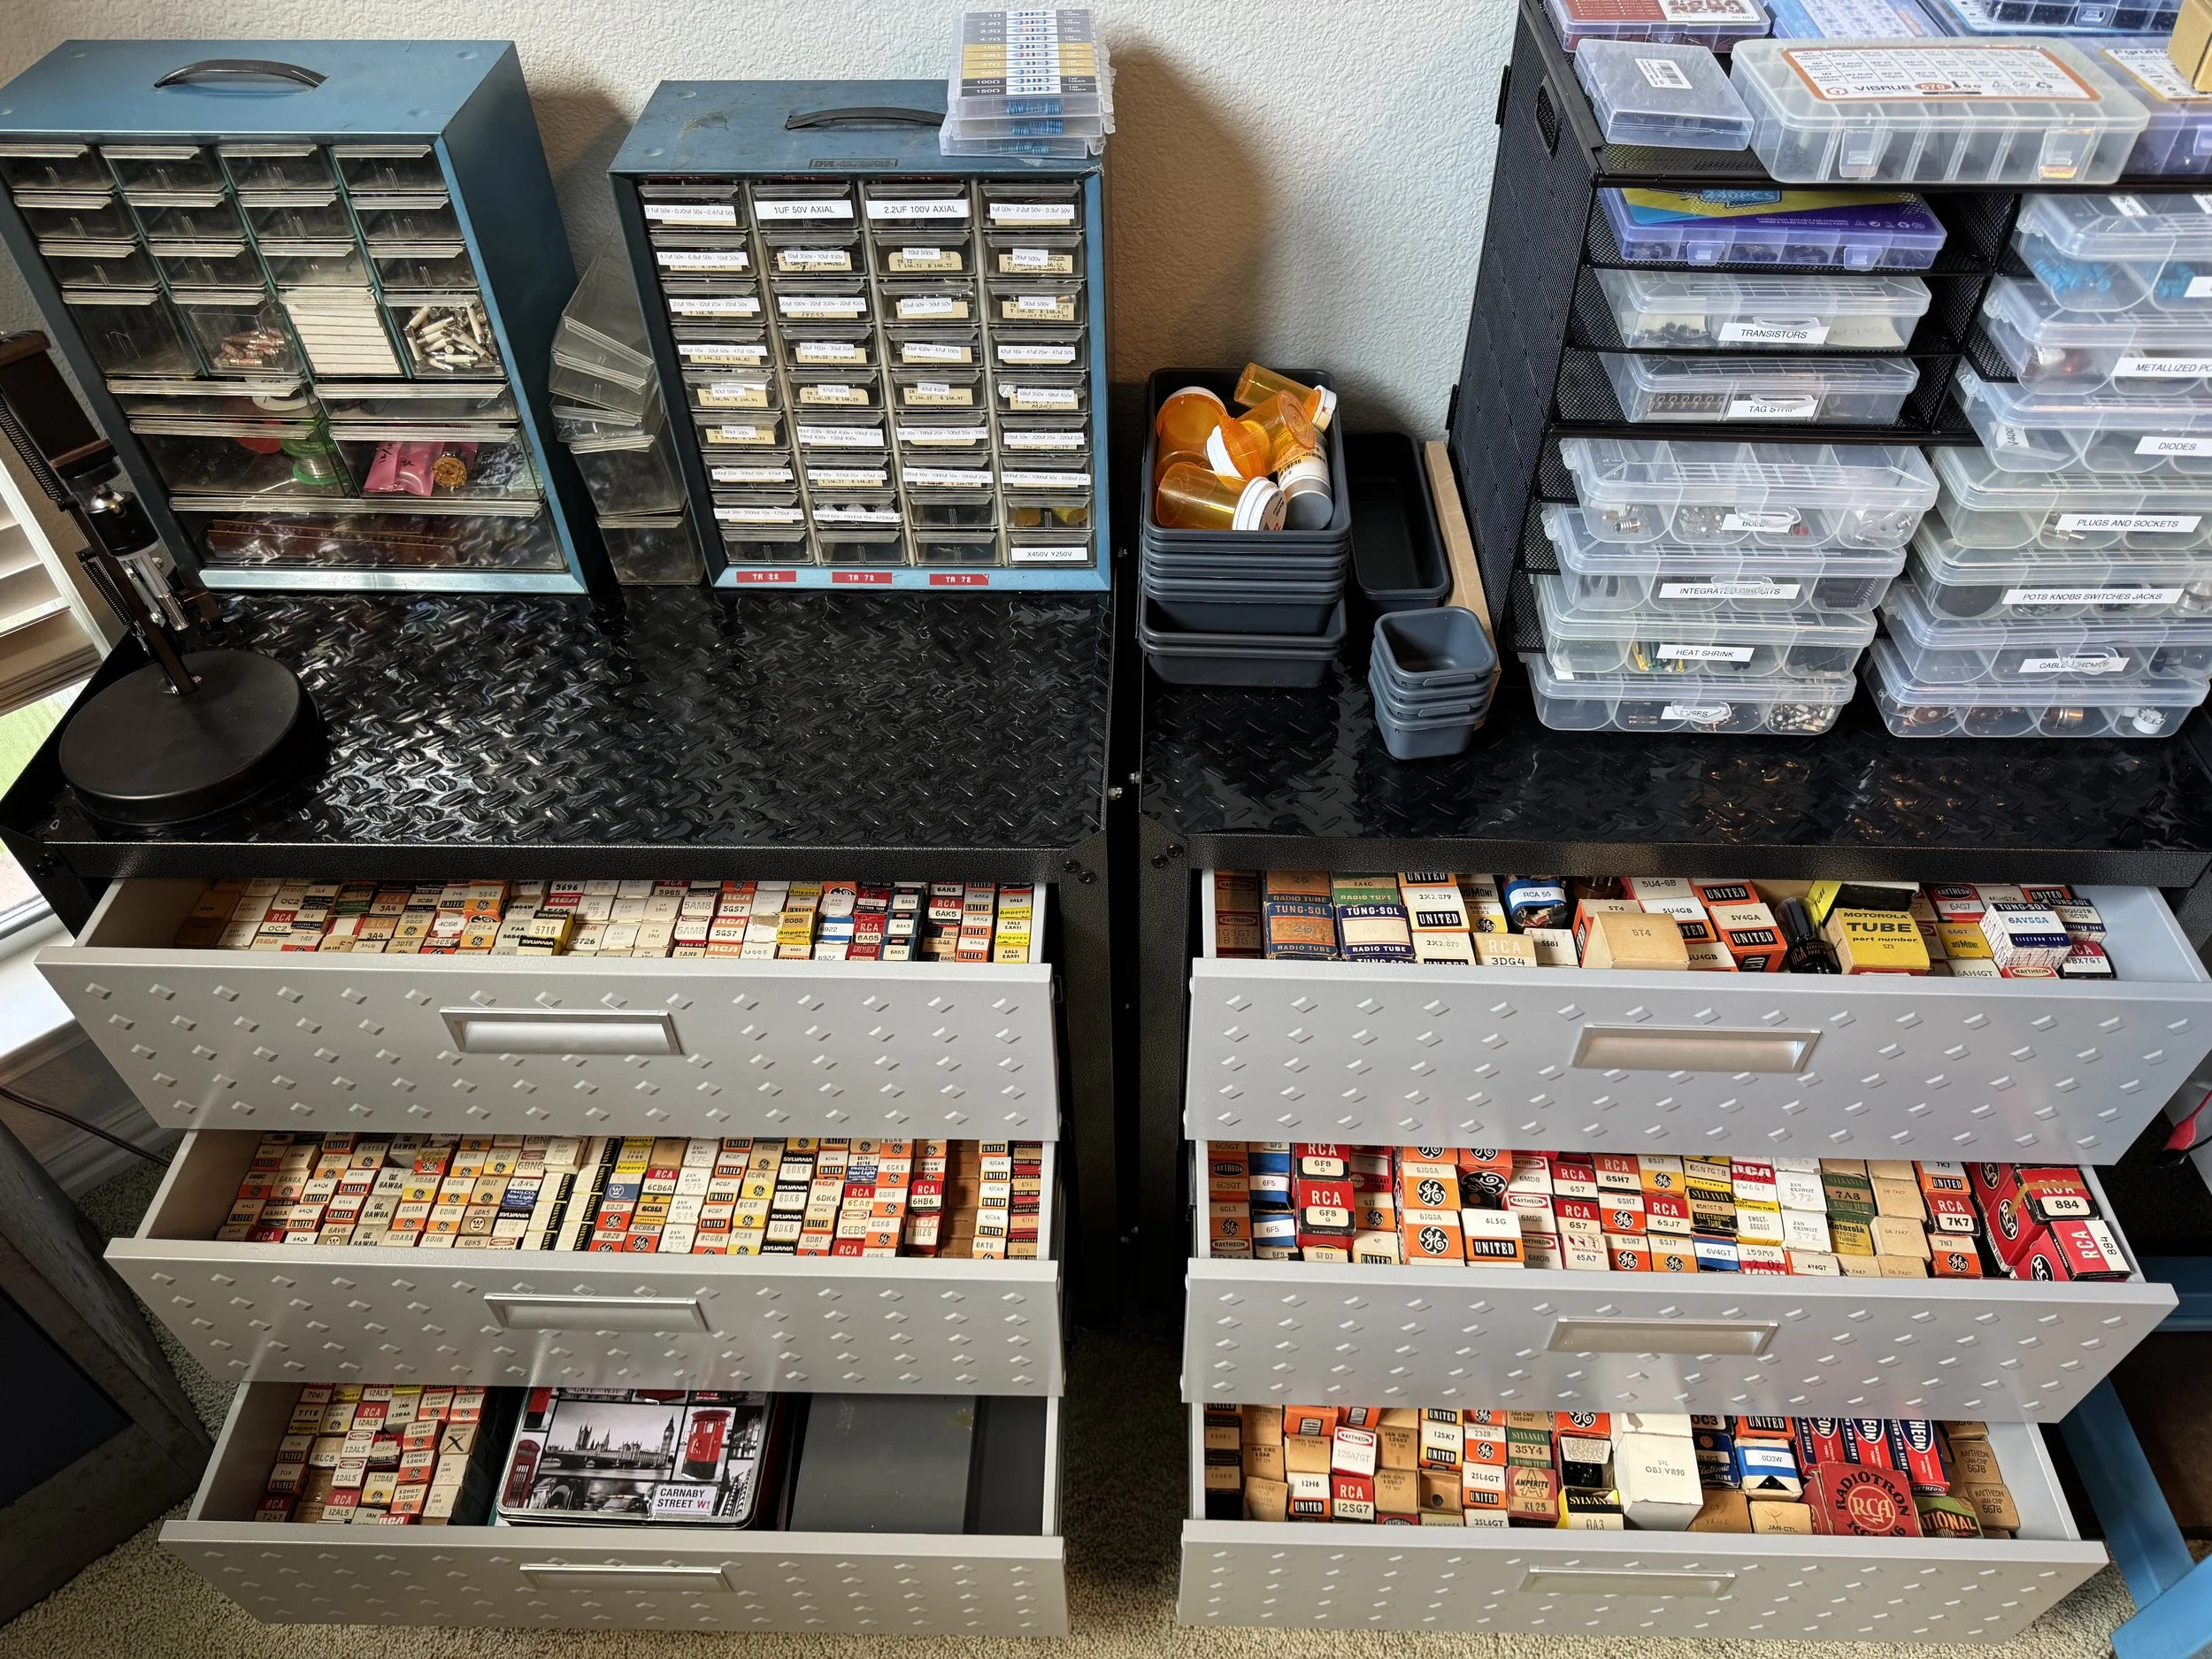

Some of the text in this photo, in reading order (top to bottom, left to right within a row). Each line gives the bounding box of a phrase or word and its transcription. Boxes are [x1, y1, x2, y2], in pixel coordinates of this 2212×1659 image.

[1741, 329, 1807, 339] TRANSISTORS
[1706, 887, 1746, 899] UNITED
[1938, 887, 1970, 897] RAYTHEON
[1276, 906, 1327, 915] TUNG-SOL
[1419, 913, 1459, 925] UNITED
[1847, 922, 1911, 933] TUBE
[1732, 932, 1773, 943] UNITED
[1489, 939, 1522, 954] RCA
[1308, 1144, 1338, 1156] RCA
[1604, 1159, 1630, 1171] RCA
[1561, 1169, 1586, 1180] RCA
[1933, 1179, 1962, 1188] UNITED
[1312, 1190, 1341, 1205] RCA
[1837, 1191, 1861, 1200] 7A8
[1653, 1202, 1678, 1216] RCA
[1938, 1201, 1964, 1212] RCA
[2055, 1200, 2079, 1209] 884
[1565, 1205, 1590, 1218] RCA
[1947, 1217, 1969, 1226] 7K7
[256, 1232, 274, 1240] RCA
[839, 1245, 857, 1254] RCA
[1475, 1241, 1515, 1255] UNITED
[2075, 1231, 2100, 1259] RCA
[2100, 1236, 2116, 1255] 884
[363, 1408, 380, 1417] RCA
[1749, 1417, 1784, 1429] UNITED
[1340, 1432, 1370, 1443] RAYTHEON
[1427, 1449, 1455, 1462] UNITED
[1515, 1446, 1543, 1455] 35Y4
[1471, 1472, 1499, 1482] 25L6GT
[1515, 1479, 1548, 1488] AMPERITE
[660, 1488, 704, 1498] CARNABY
[1340, 1485, 1363, 1499] RCA
[1470, 1492, 1498, 1503] UNITED
[1836, 1471, 1910, 1517] RADIOTRON
[334, 1495, 351, 1504] RCA
[657, 1499, 693, 1508] STREET
[1294, 1502, 1323, 1512] UNITED
[1338, 1502, 1370, 1512] 12SG7
[1525, 1502, 1547, 1511] KL25
